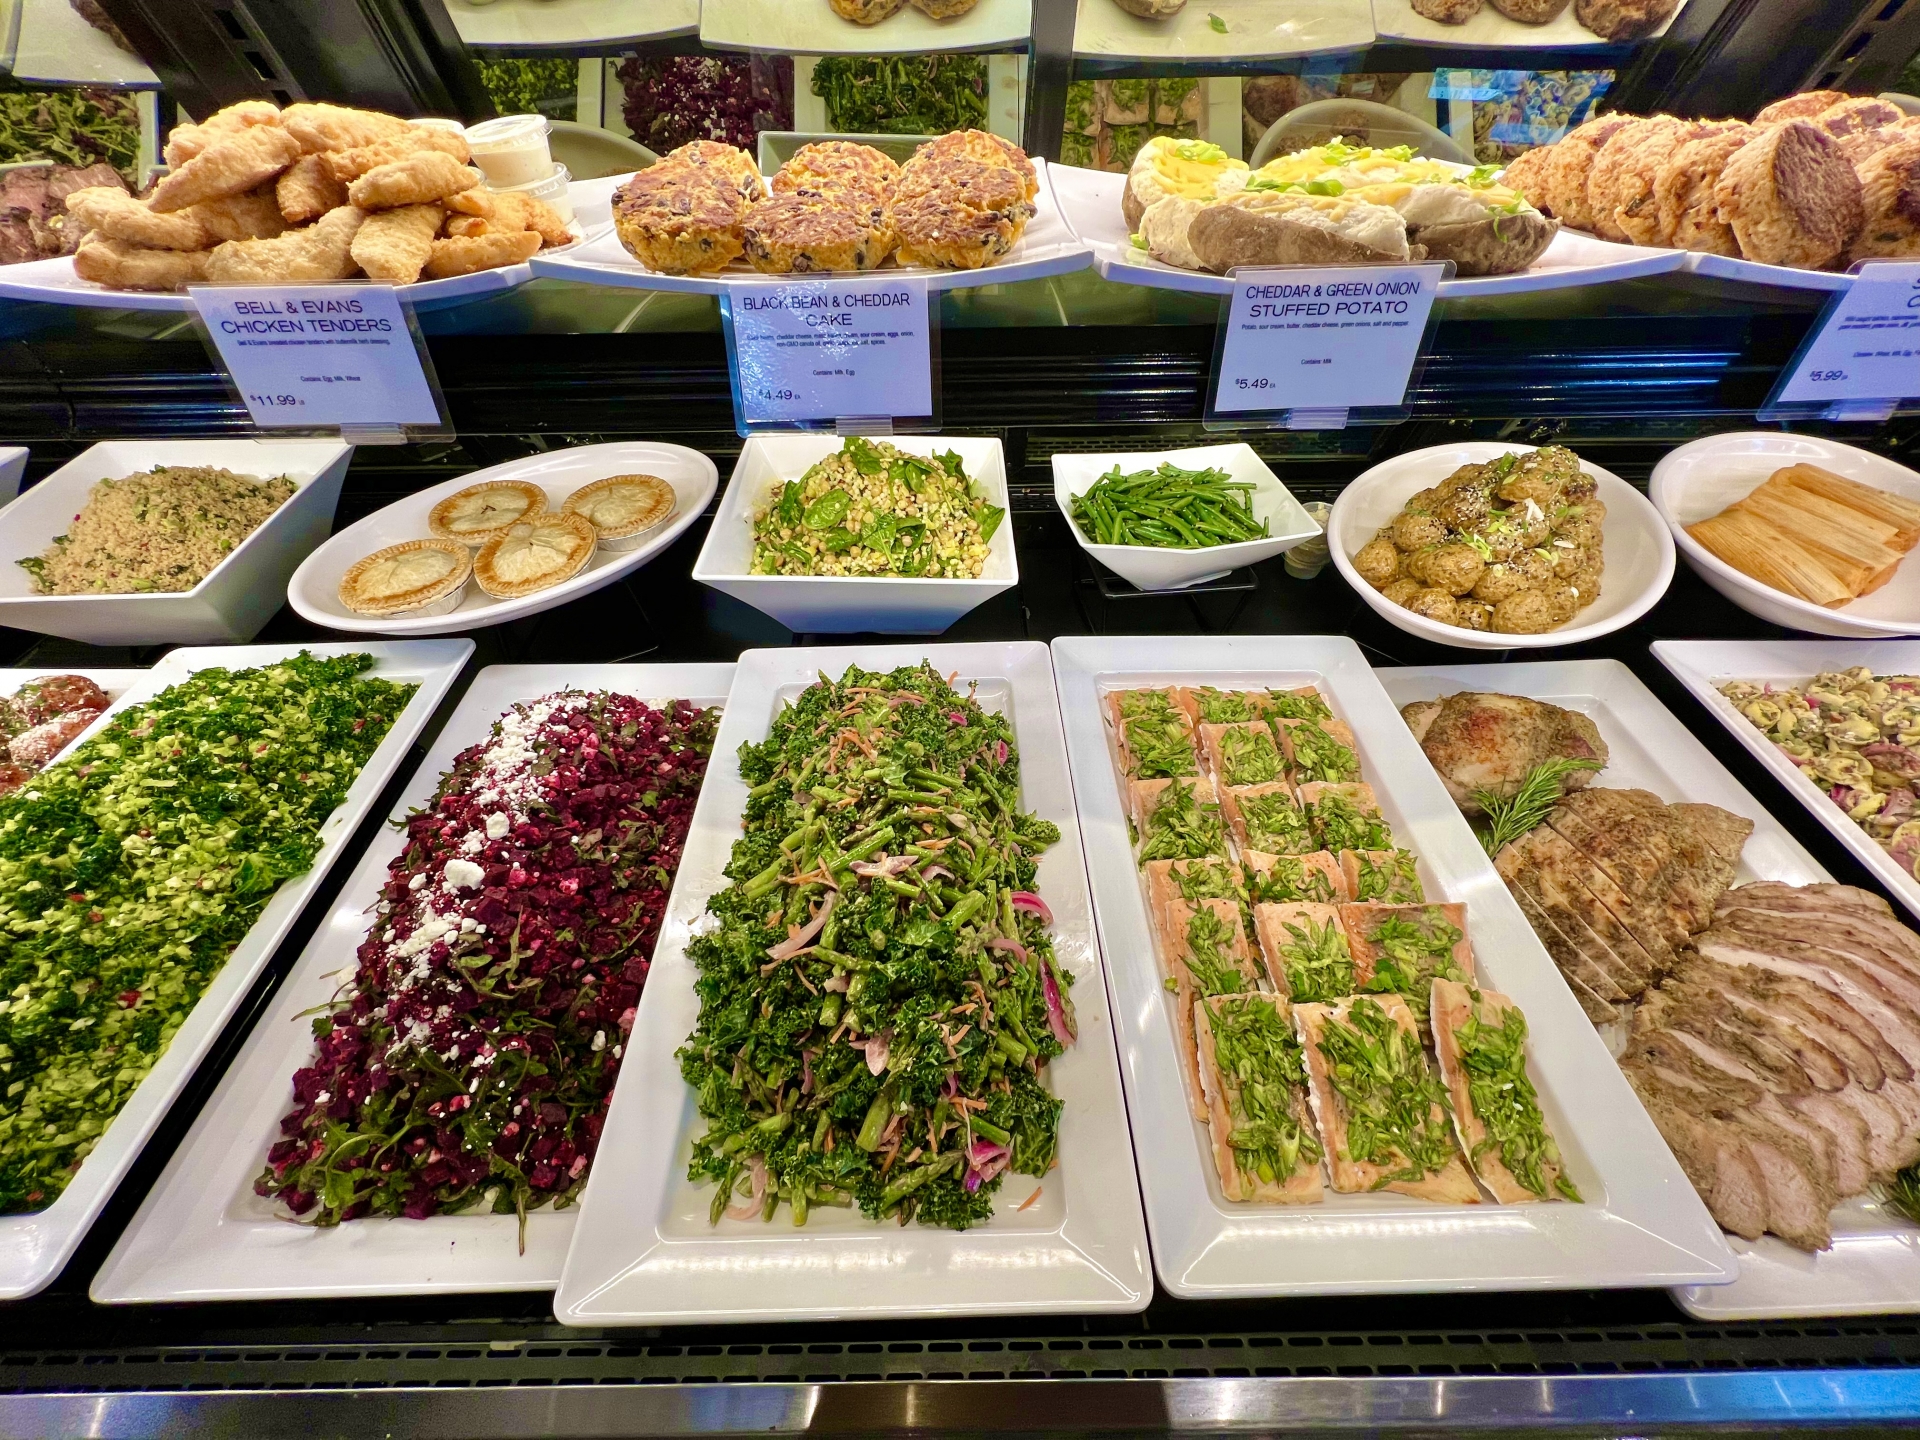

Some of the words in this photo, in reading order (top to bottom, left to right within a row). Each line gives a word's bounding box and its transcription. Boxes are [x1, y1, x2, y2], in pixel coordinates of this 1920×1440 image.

[1246, 285, 1310, 299] CHEDDAR
[1313, 284, 1322, 298] &
[1326, 282, 1374, 297] GREEN
[1375, 281, 1421, 296] ONION
[235, 300, 283, 315] BELL
[286, 300, 299, 313] &
[302, 299, 363, 313] EVANS
[743, 295, 789, 310] BLACK
[791, 294, 828, 309] BEAN
[832, 294, 841, 307] &
[844, 292, 911, 307] CHEDDAR
[1249, 303, 1330, 318] STUFFED
[1335, 300, 1408, 315] POTATO
[221, 319, 305, 334] CHICKEN
[307, 318, 392, 333] TENDERS
[805, 313, 853, 327] CAKE
[1234, 377, 1269, 389] $5.49
[249, 394, 296, 406] $11.99
